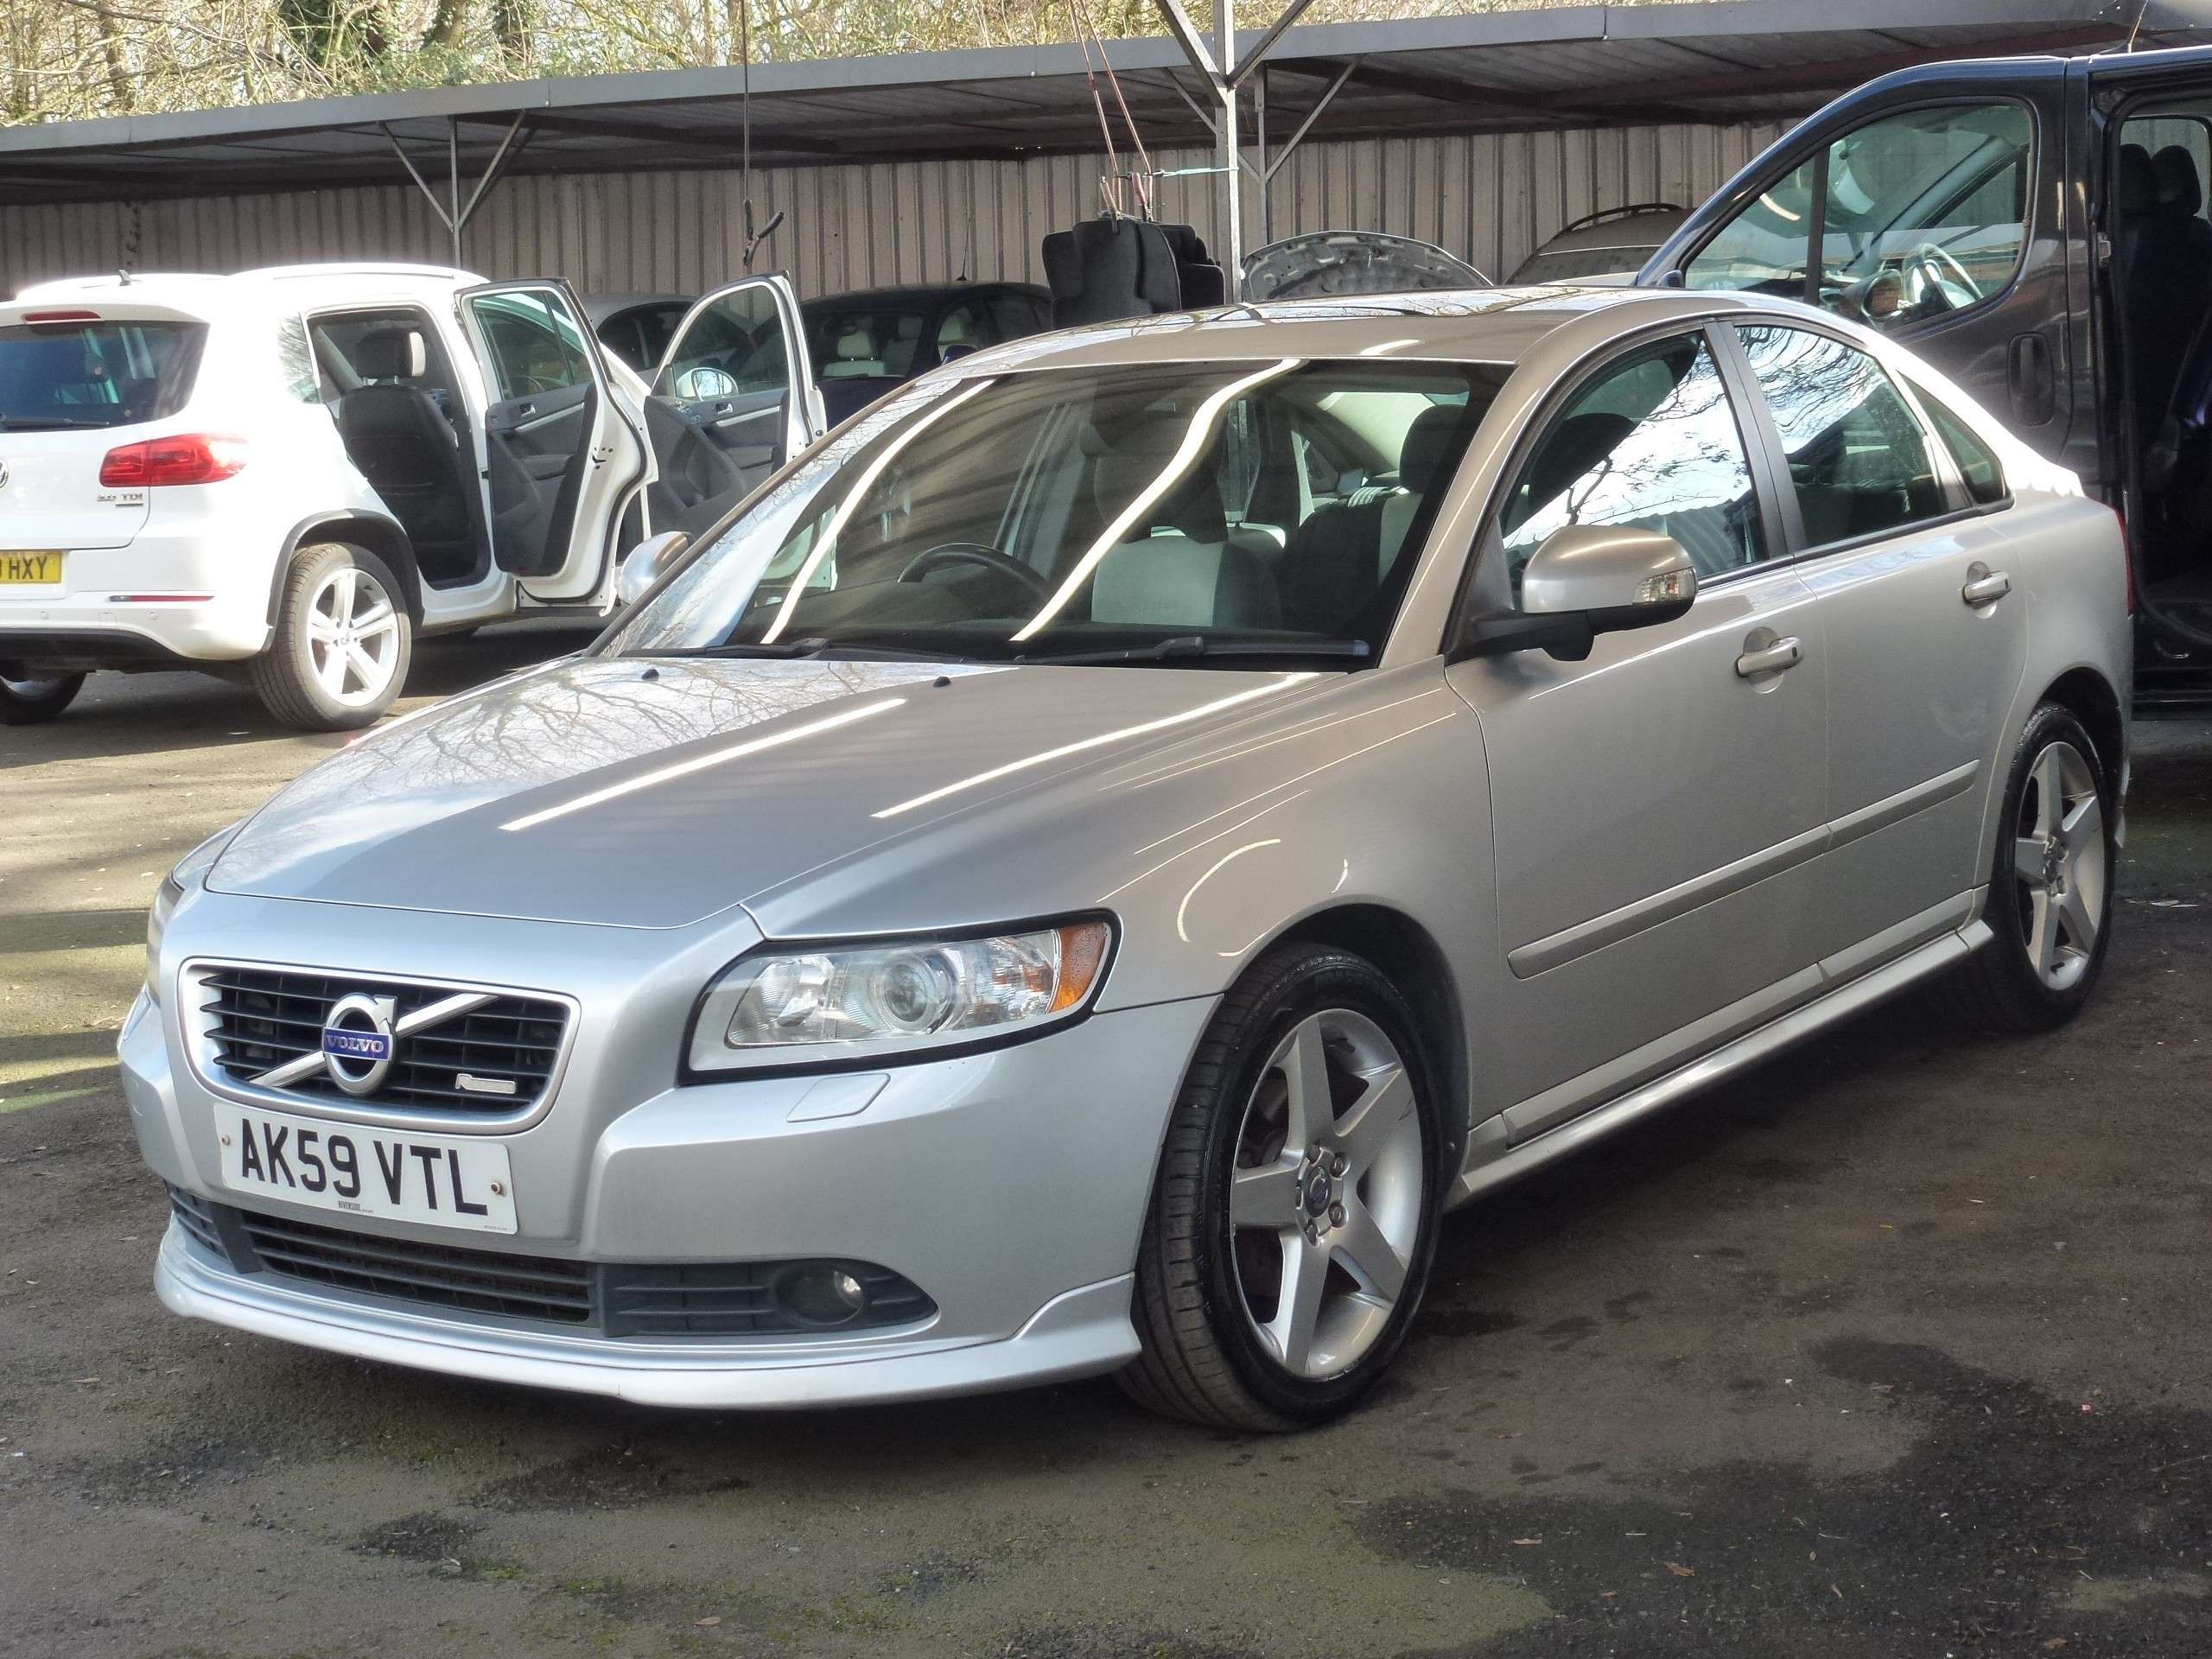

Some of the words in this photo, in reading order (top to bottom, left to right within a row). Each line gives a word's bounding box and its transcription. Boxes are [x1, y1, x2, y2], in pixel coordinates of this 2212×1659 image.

[8, 556, 48, 580] HXY
[325, 1034, 385, 1053] VOLVO
[241, 1118, 361, 1198] AK59
[372, 1140, 489, 1217] VTL
